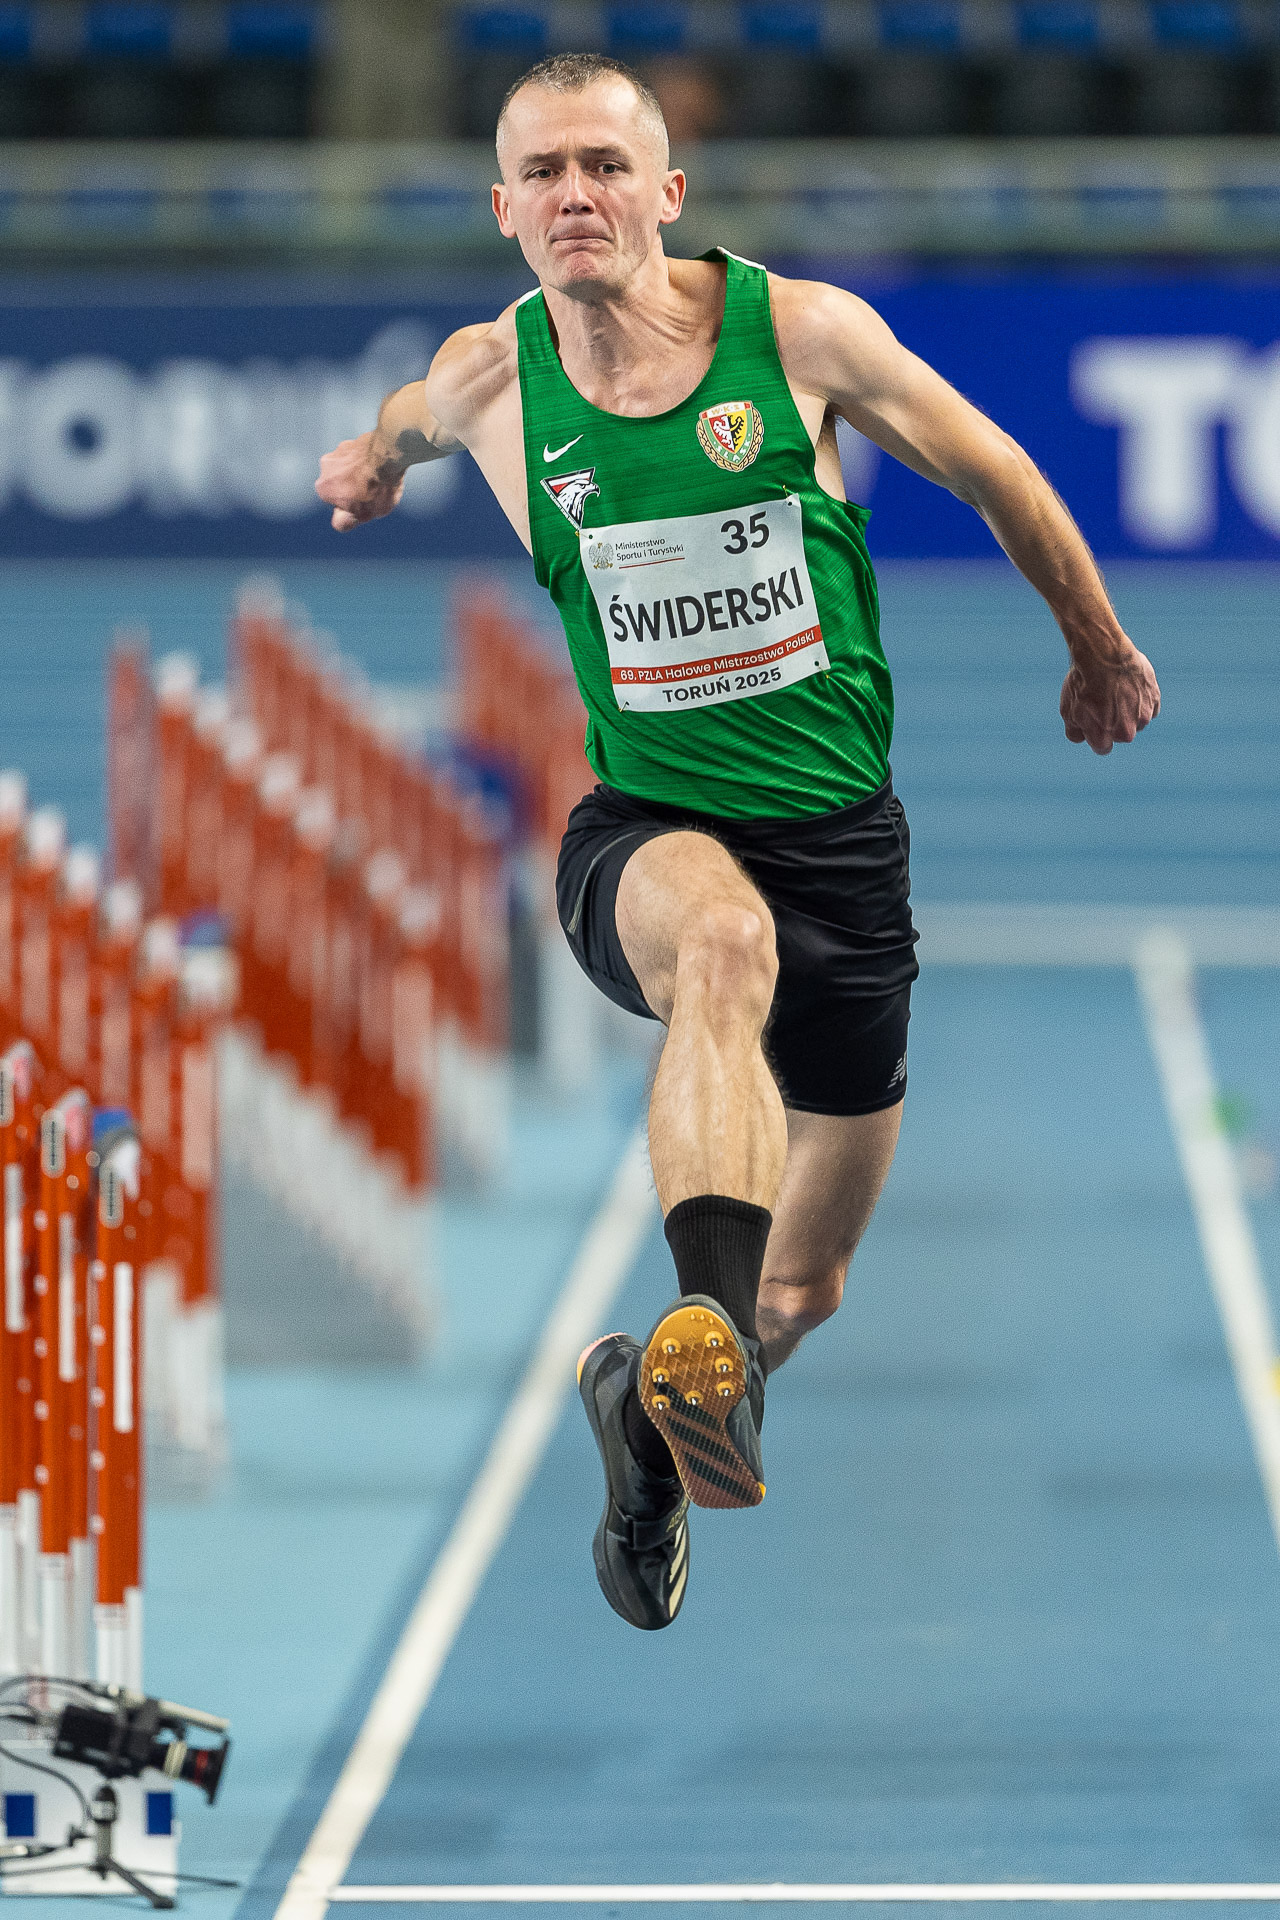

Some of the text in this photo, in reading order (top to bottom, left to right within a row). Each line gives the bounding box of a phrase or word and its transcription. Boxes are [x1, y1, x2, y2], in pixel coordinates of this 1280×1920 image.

[615, 538, 666, 551] Ministerstwo
[616, 551, 642, 561] Sportu
[648, 544, 684, 556] Turystyki
[720, 510, 770, 555] 35
[608, 566, 805, 643] ŚWIDERSKI
[620, 629, 815, 681] 69. PZLA Halowe Mistrzostwa Polski
[662, 667, 782, 703] TORUŃ 2025
